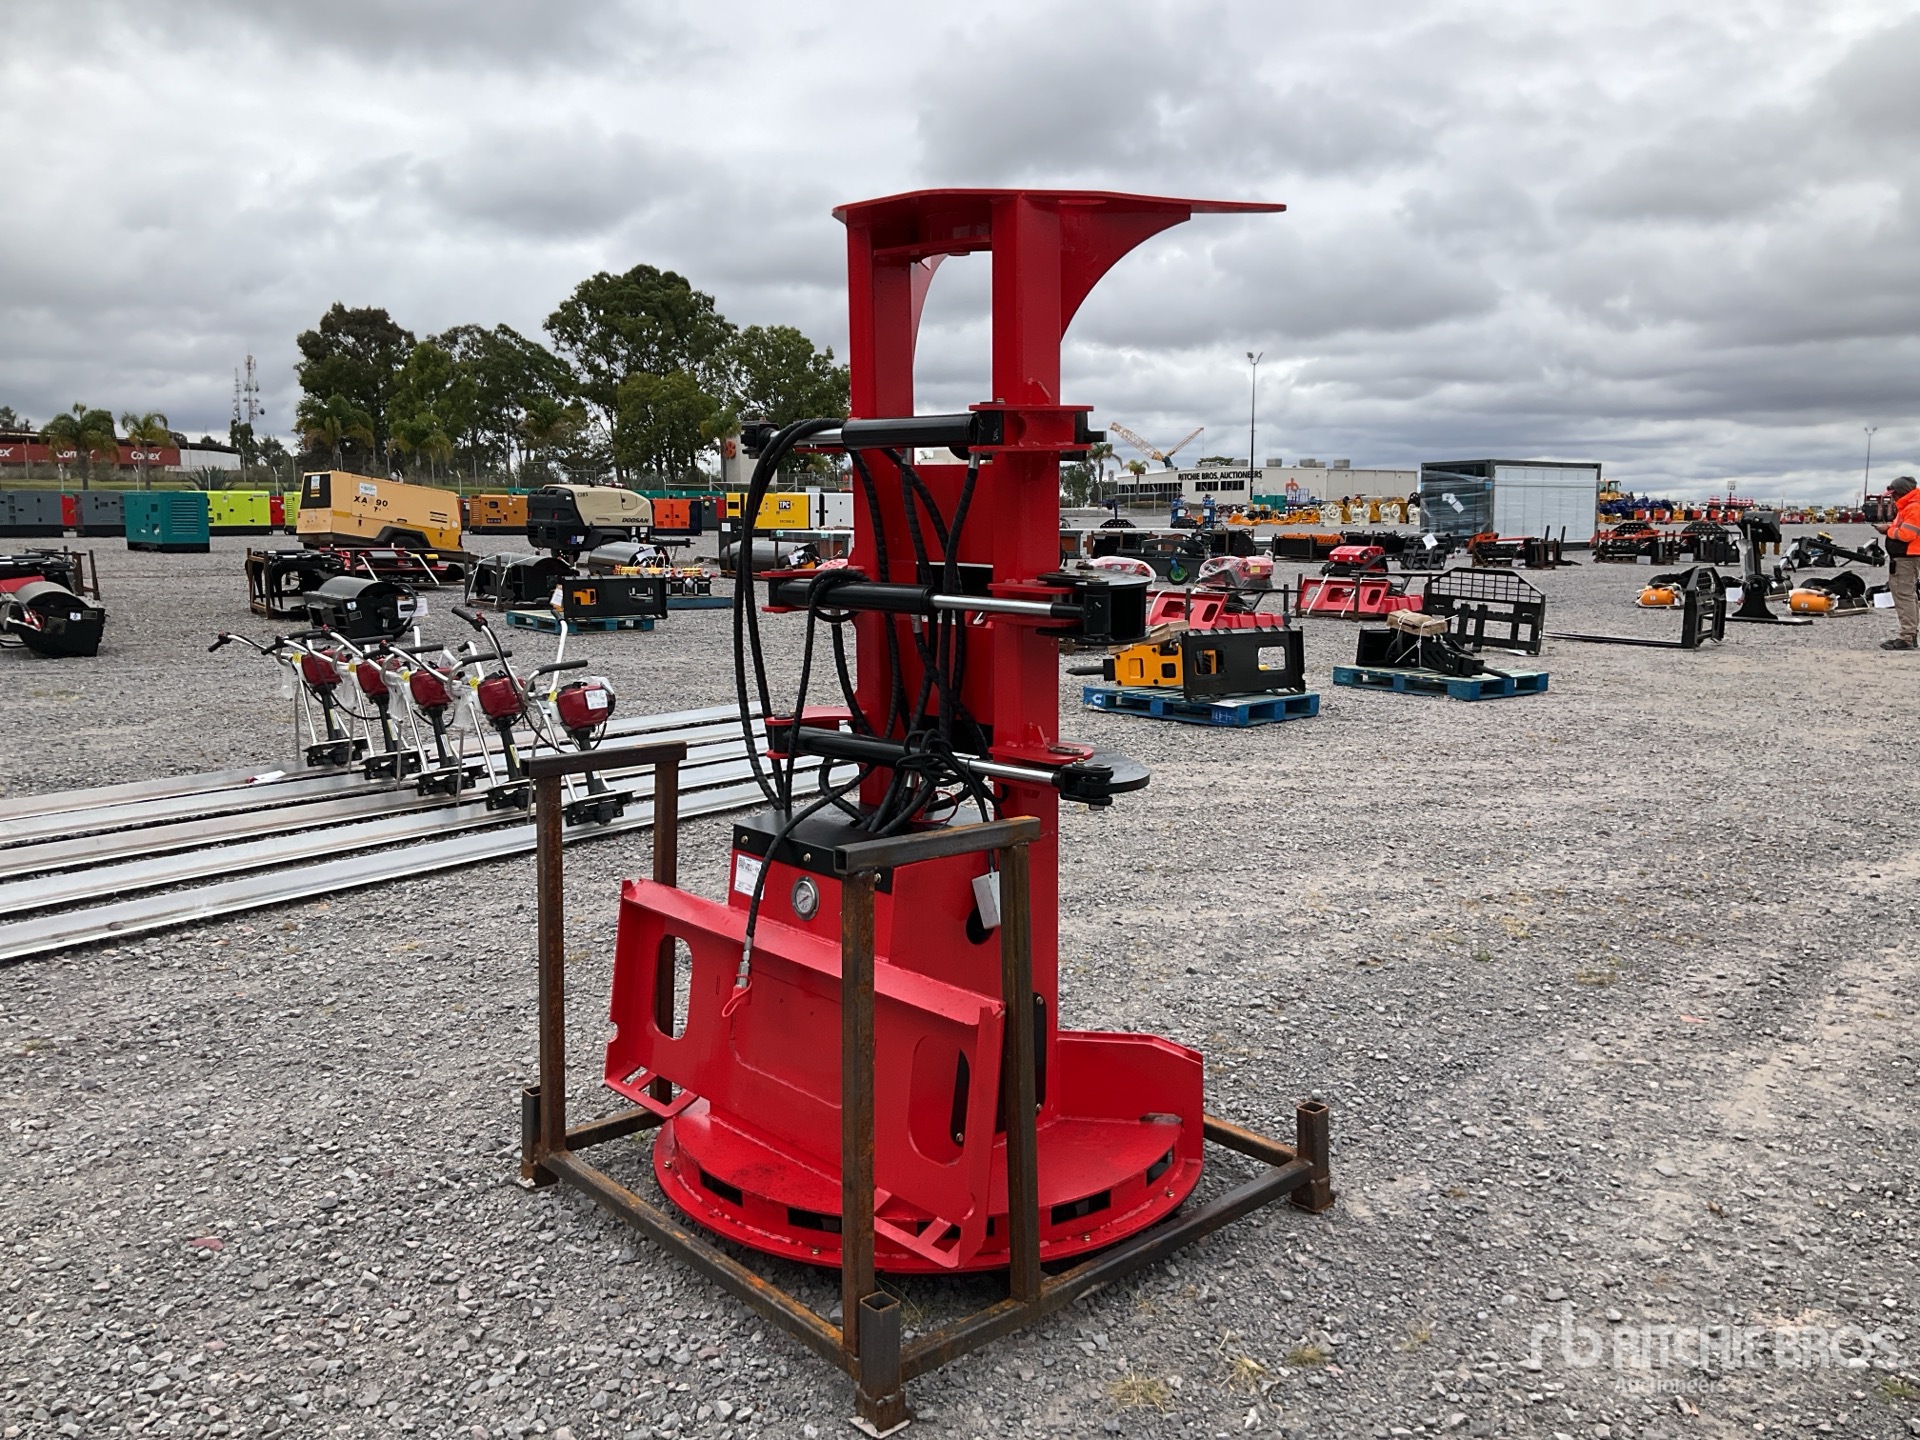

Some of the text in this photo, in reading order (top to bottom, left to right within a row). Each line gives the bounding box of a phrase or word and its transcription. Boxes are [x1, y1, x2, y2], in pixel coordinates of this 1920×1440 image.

[130, 450, 162, 461] Coex
[1178, 472, 1200, 481] RITCHIE
[779, 501, 790, 509] TPC
